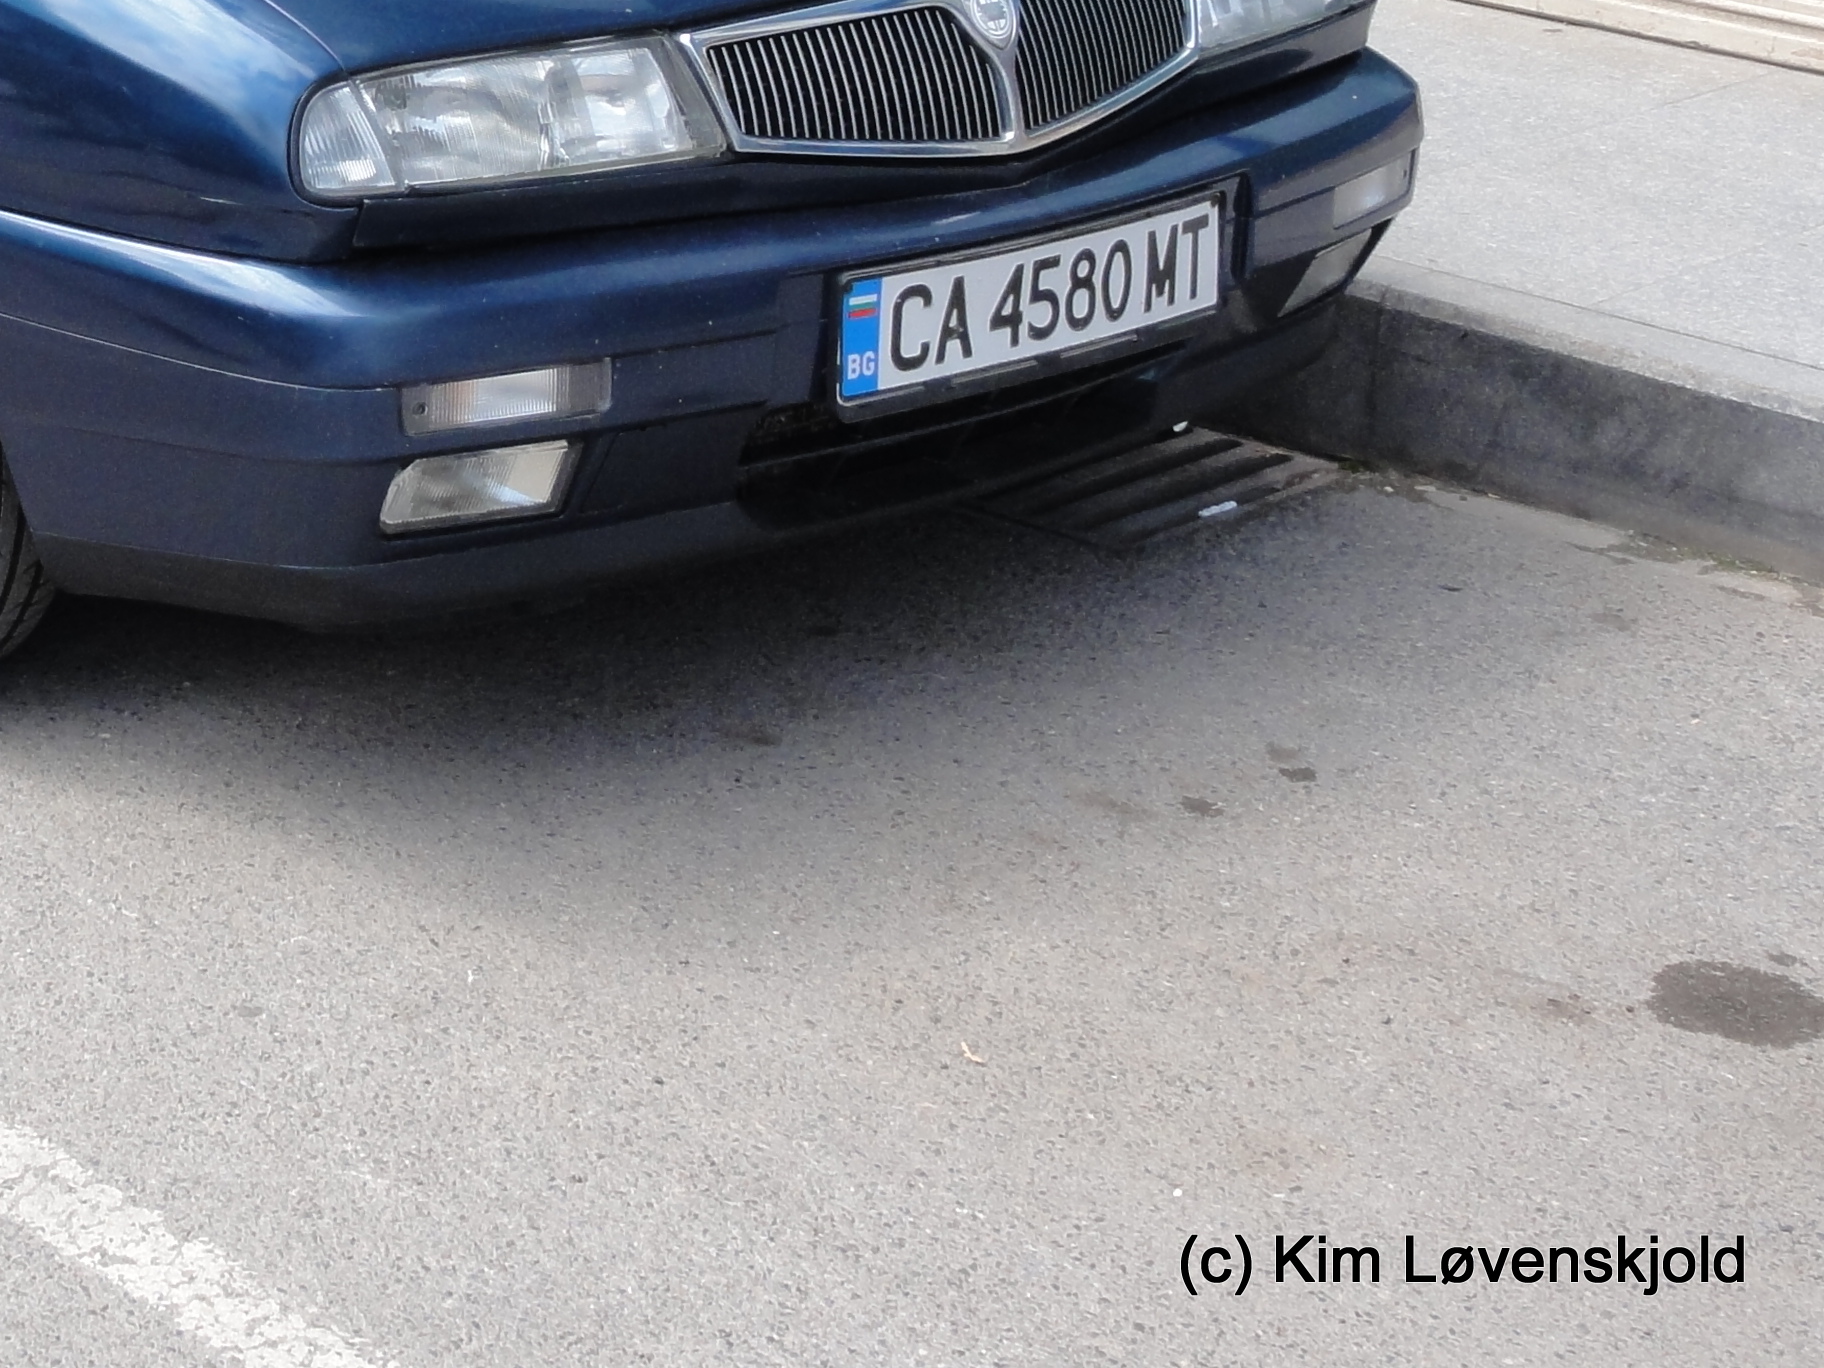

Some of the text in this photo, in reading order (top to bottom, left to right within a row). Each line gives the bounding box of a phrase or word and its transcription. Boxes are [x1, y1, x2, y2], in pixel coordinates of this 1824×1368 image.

[889, 214, 1210, 372] CA 4580 MT
[847, 350, 876, 380] BG
